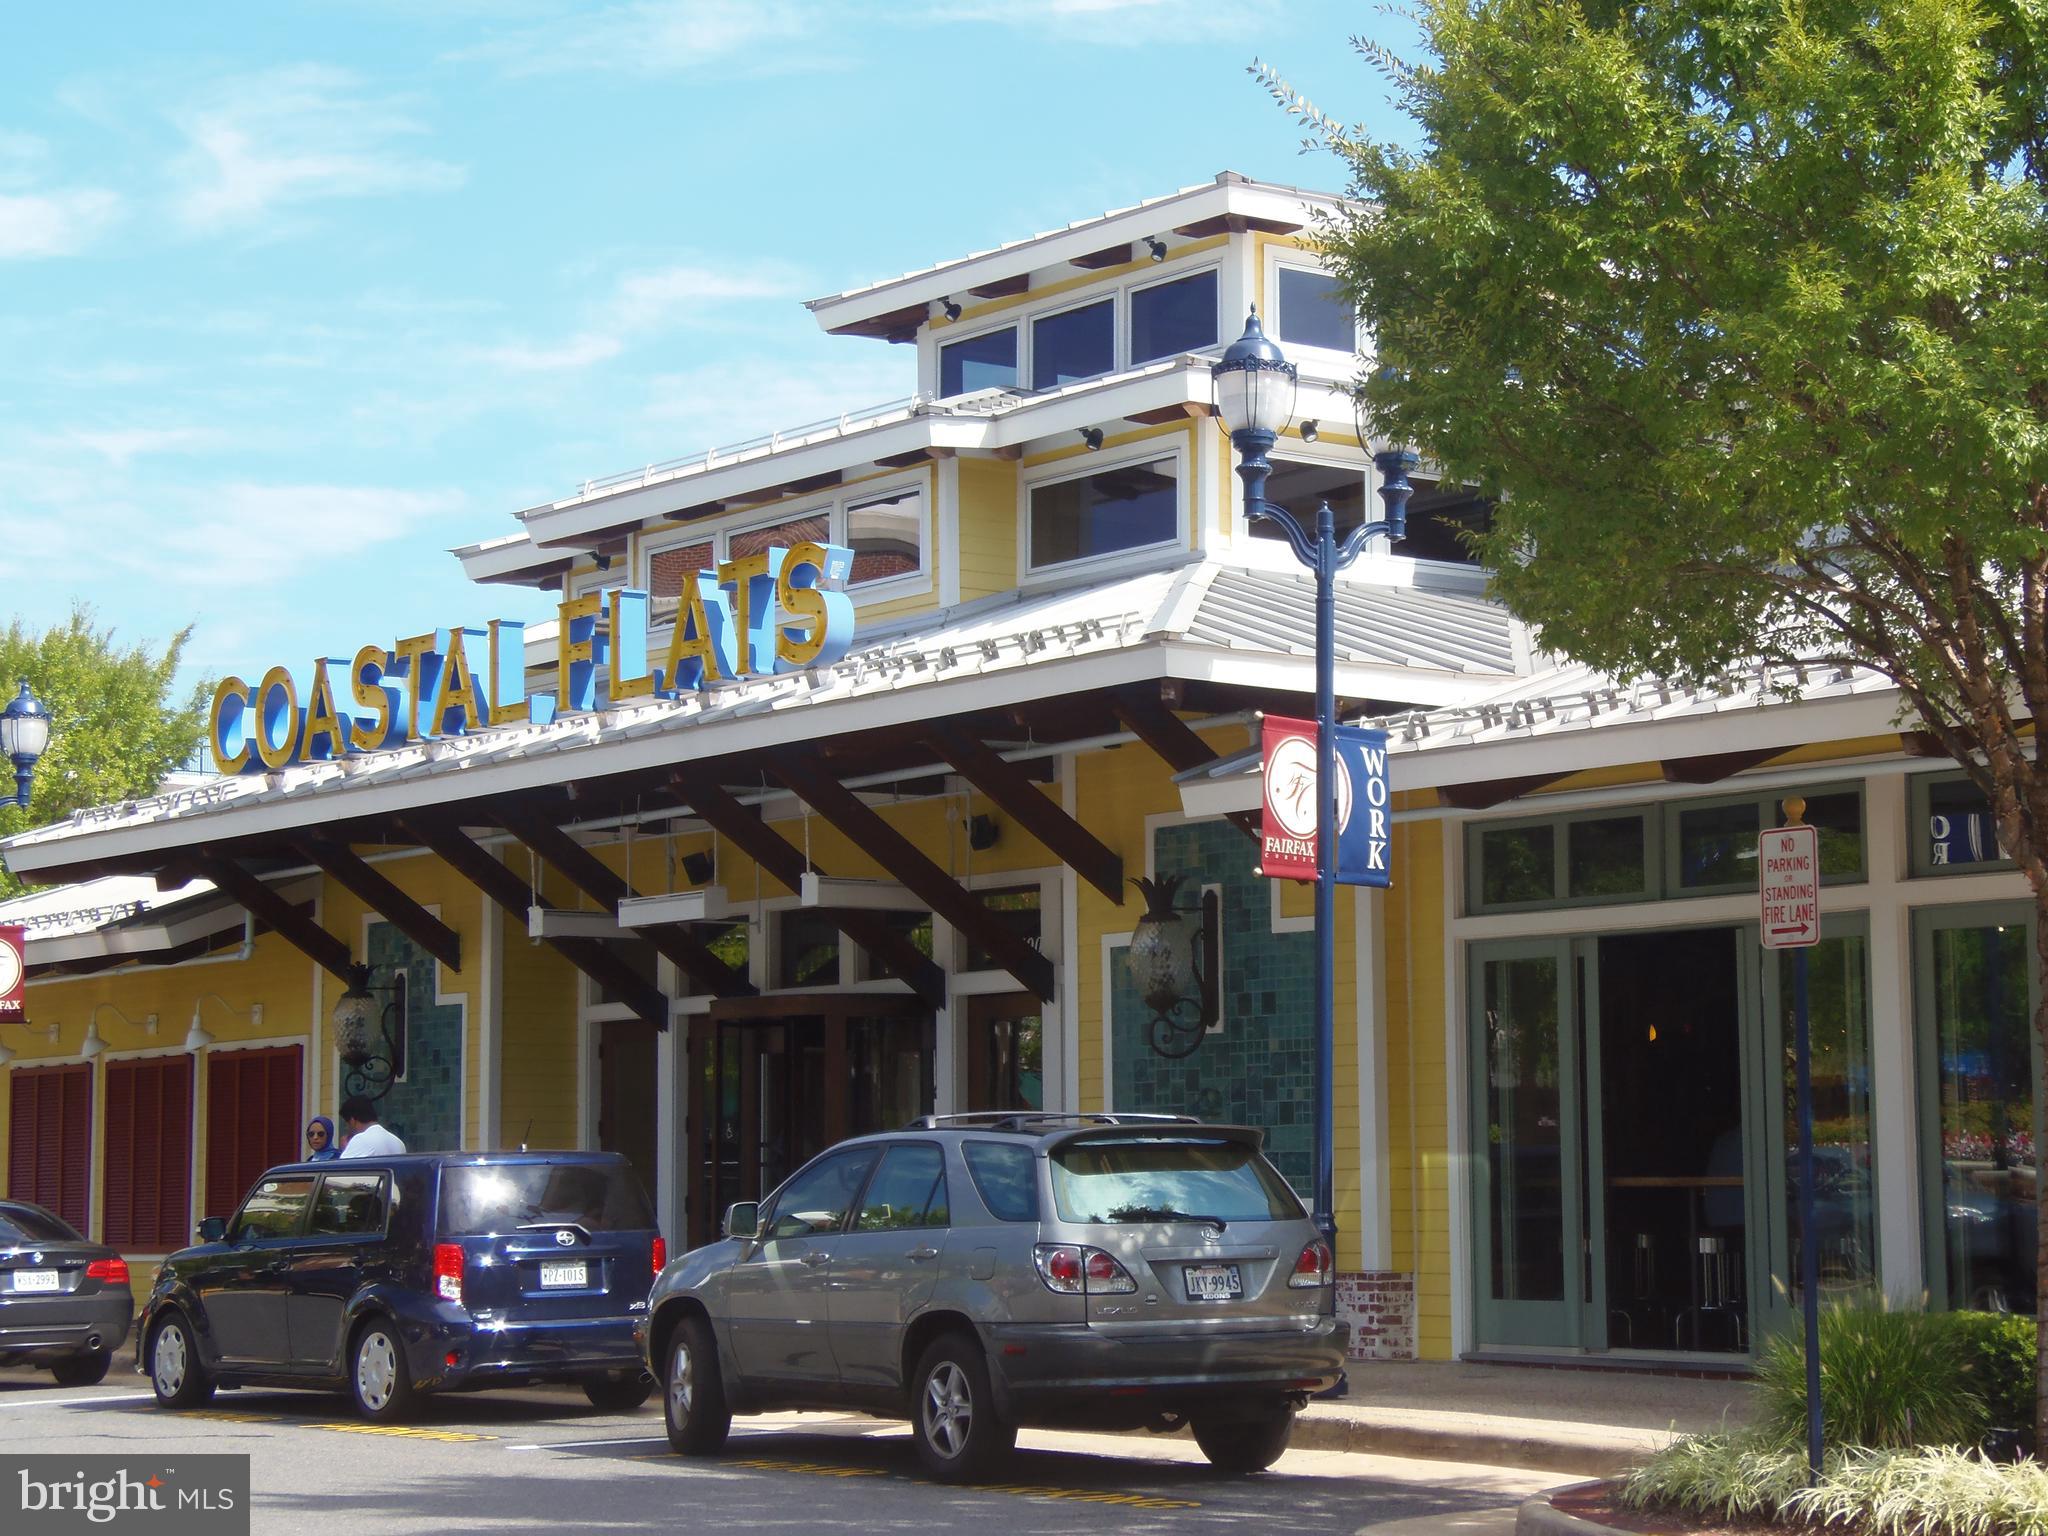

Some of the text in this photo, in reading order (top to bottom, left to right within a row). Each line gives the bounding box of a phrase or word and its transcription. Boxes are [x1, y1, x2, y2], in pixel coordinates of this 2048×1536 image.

[210, 541, 853, 776] COASTAL FLATS
[1360, 747, 1387, 870] WORK
[1265, 836, 1315, 857] FAIRFAX
[1780, 837, 1795, 853] NO
[1767, 856, 1810, 873] PARKING
[1784, 874, 1793, 882] OR
[1765, 884, 1814, 902] STANDING
[1765, 904, 1815, 924] FIRE LANE
